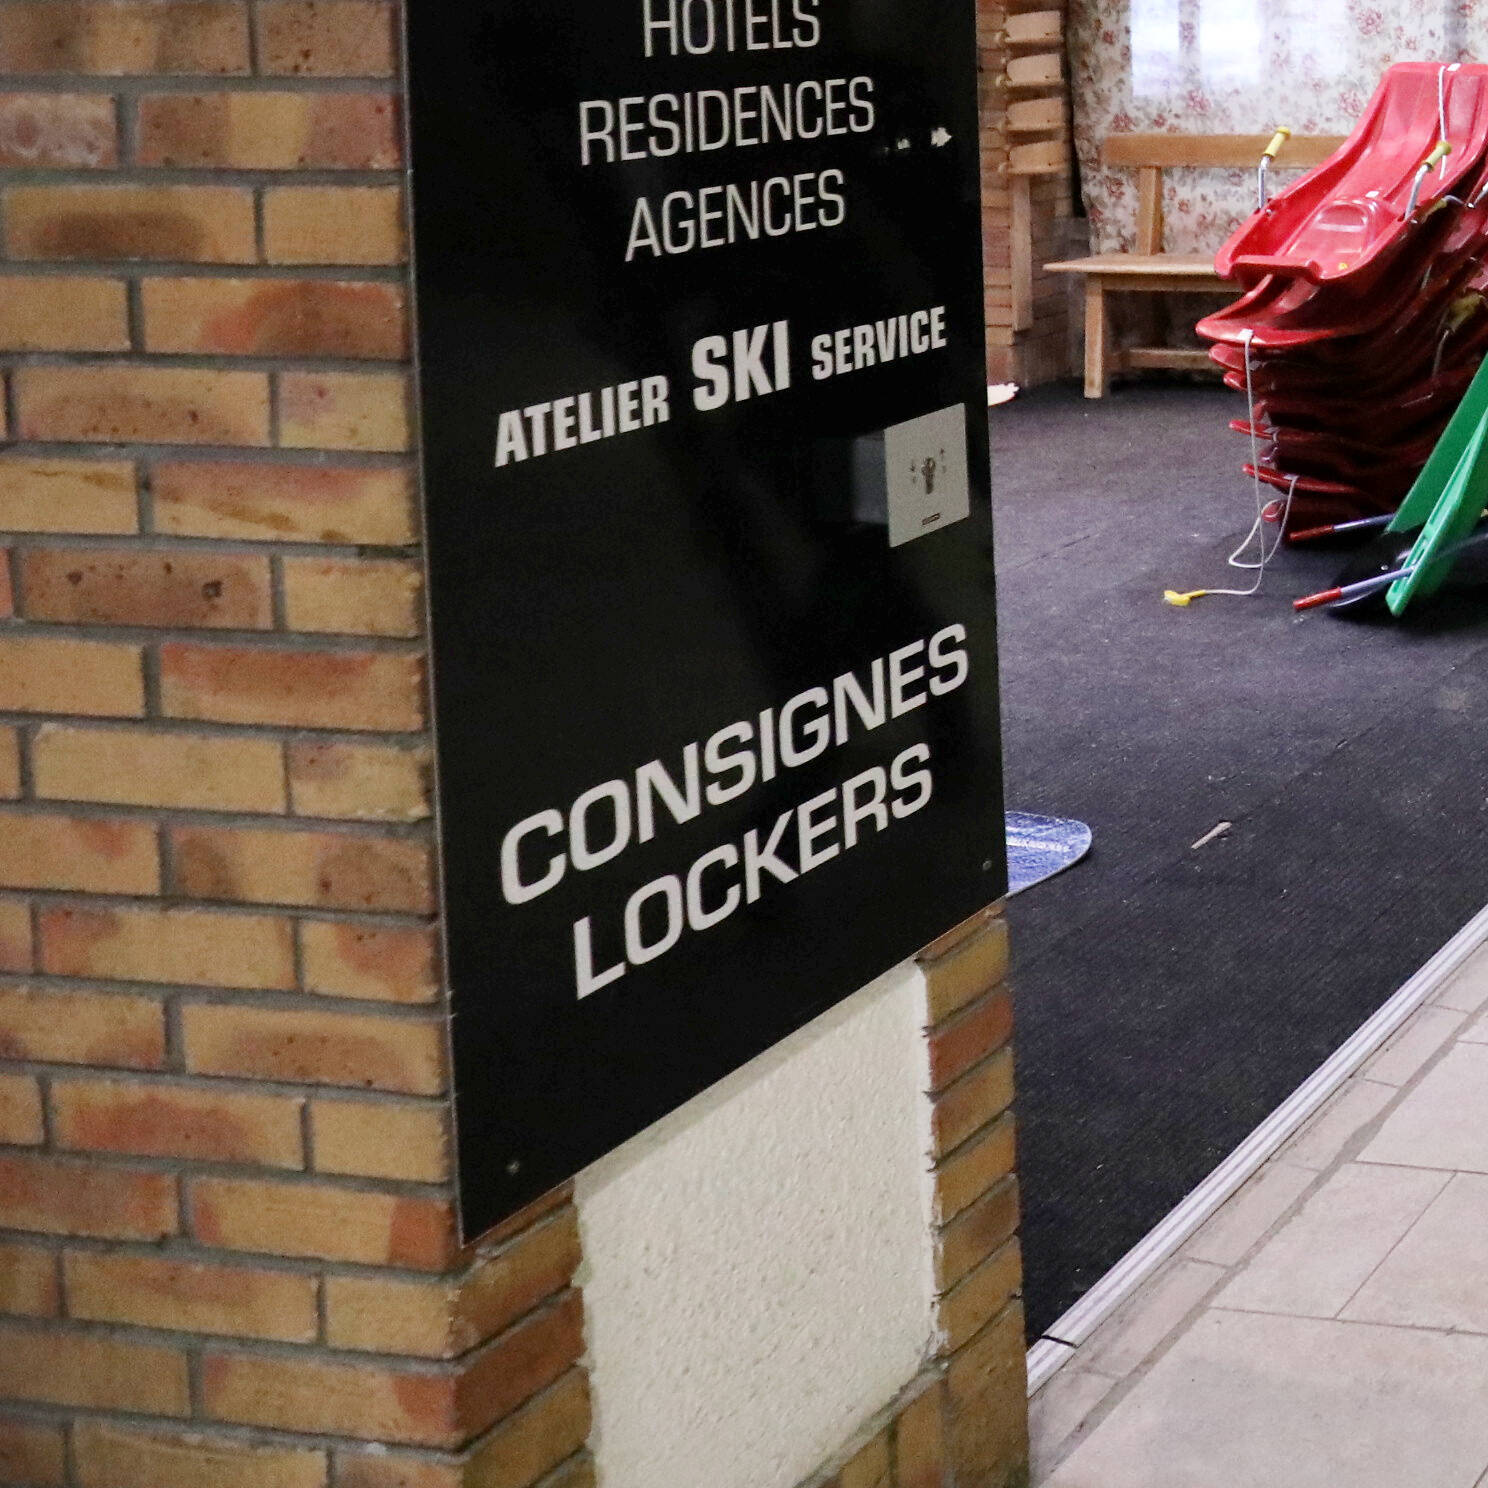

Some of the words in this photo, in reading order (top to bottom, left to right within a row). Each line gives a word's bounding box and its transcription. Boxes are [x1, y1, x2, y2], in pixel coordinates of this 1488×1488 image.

[579, 76, 875, 165] RESIDENCES
[625, 169, 846, 262] AGENCES
[495, 375, 671, 467] ATELIER
[691, 320, 790, 412] SKI
[811, 306, 947, 380] SERVICE
[500, 623, 968, 905] CONSIGNES
[573, 742, 933, 1000] LOCKERS
